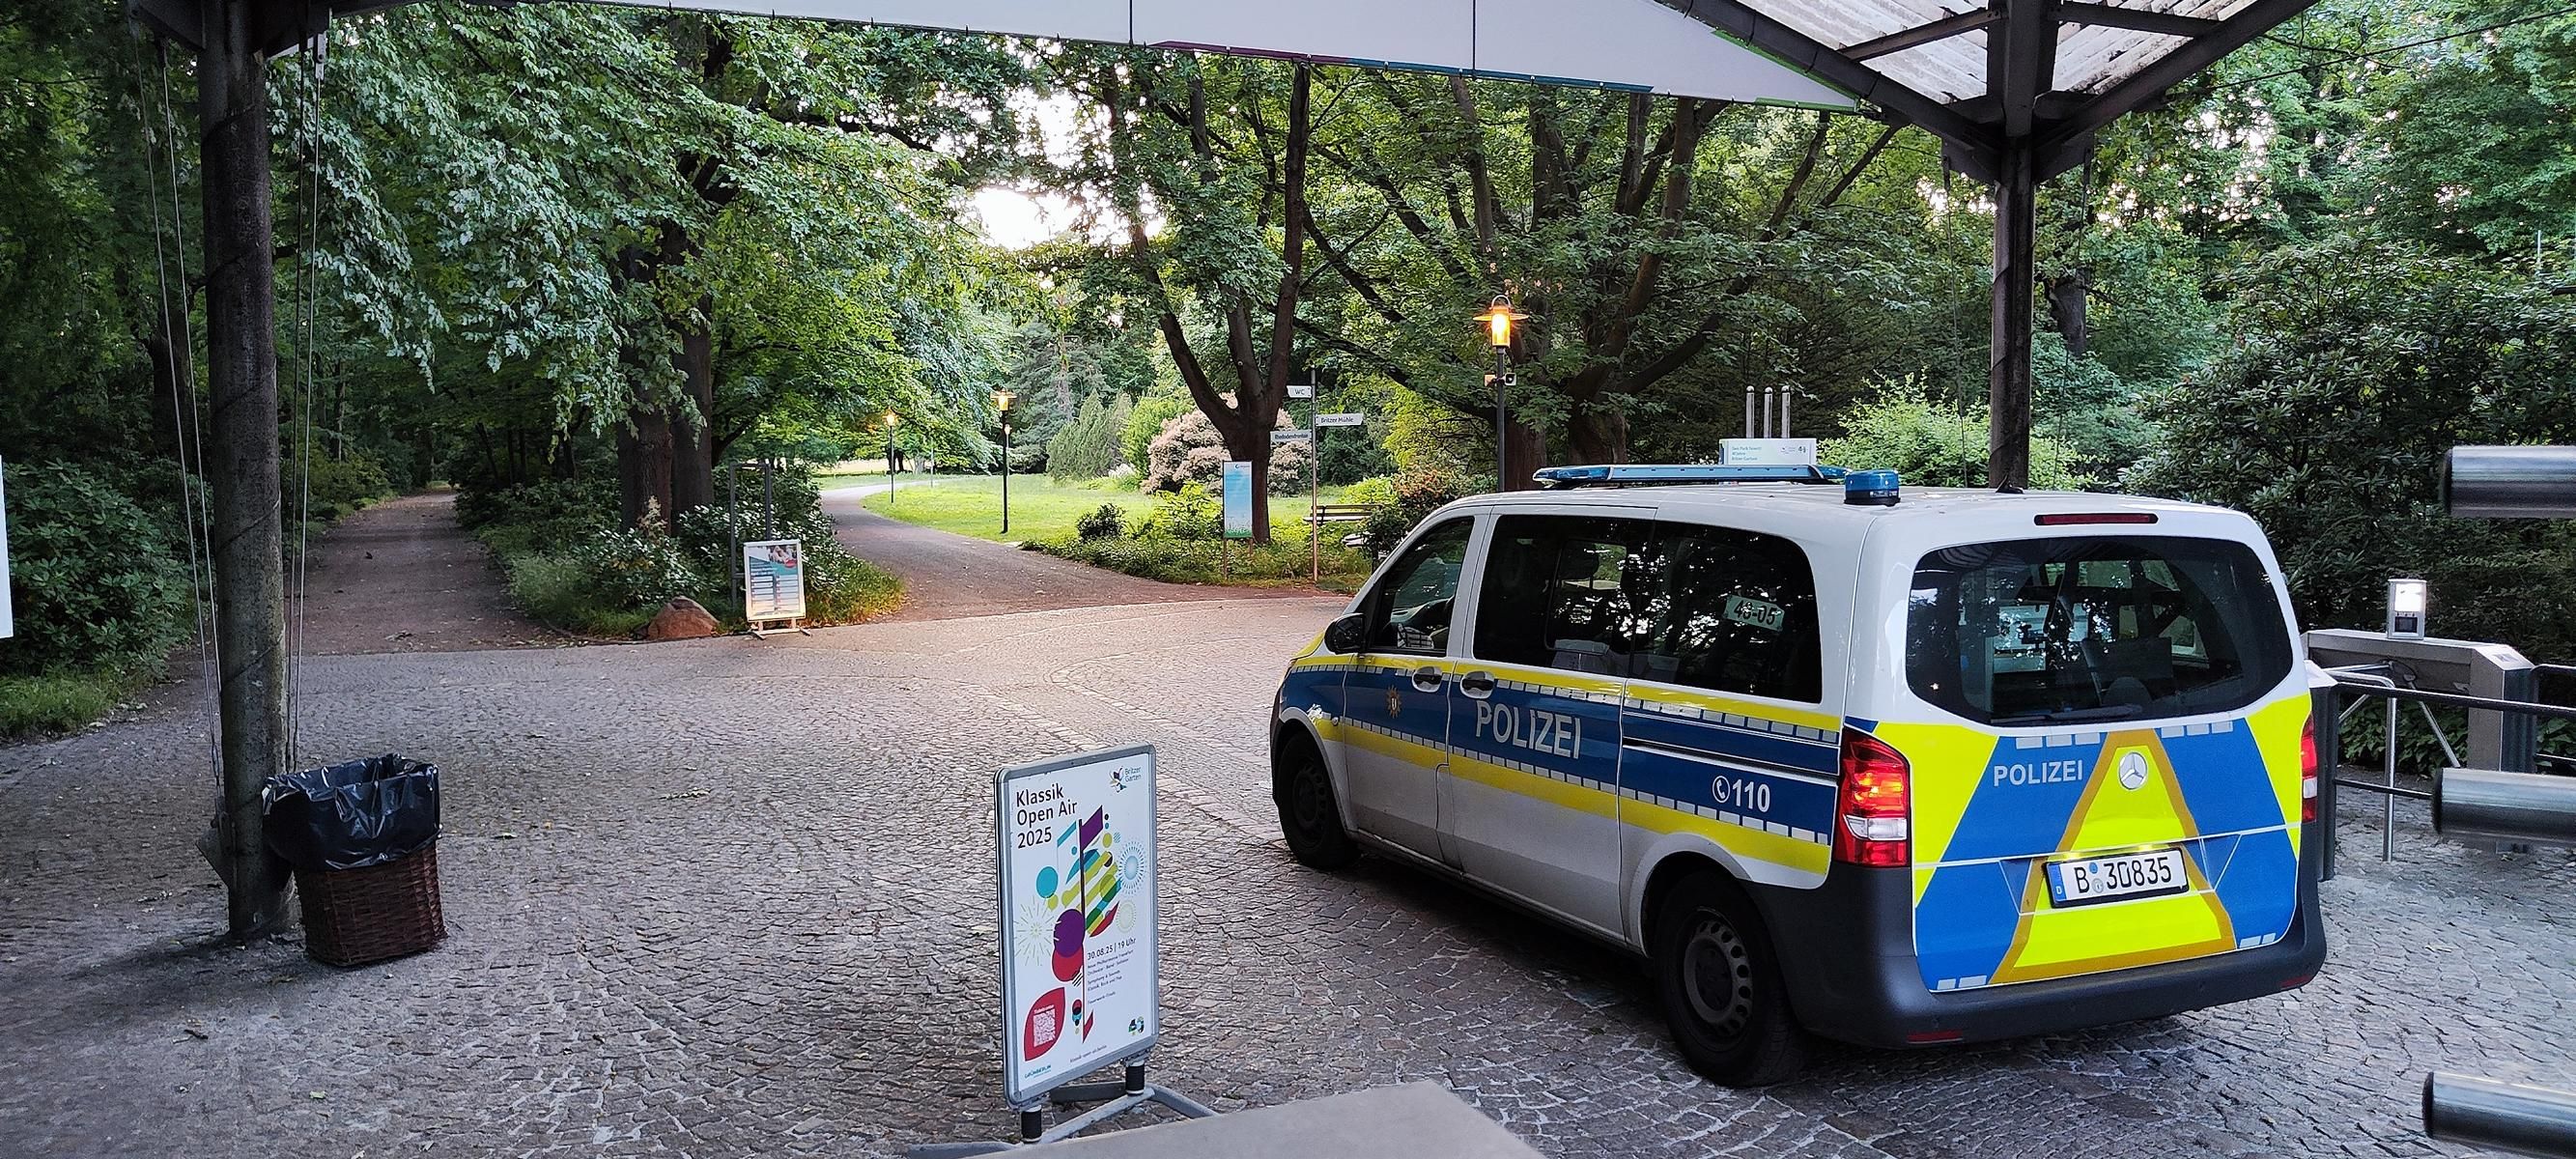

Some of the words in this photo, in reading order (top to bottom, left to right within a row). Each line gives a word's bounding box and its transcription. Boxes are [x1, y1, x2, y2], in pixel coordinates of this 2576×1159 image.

[1476, 698, 1582, 760] POLIZEI
[1994, 759, 2083, 787] POLIZEI
[1016, 782, 1063, 807] Klassik
[1731, 779, 1771, 813] 110
[1017, 807, 1054, 828] Open
[1059, 801, 1078, 817] Air
[1017, 826, 1052, 848] 2025
[2055, 886, 2063, 894] D
[2074, 866, 2090, 894] B
[2104, 857, 2172, 890] 30835
[1125, 938, 1137, 947] Uhr
